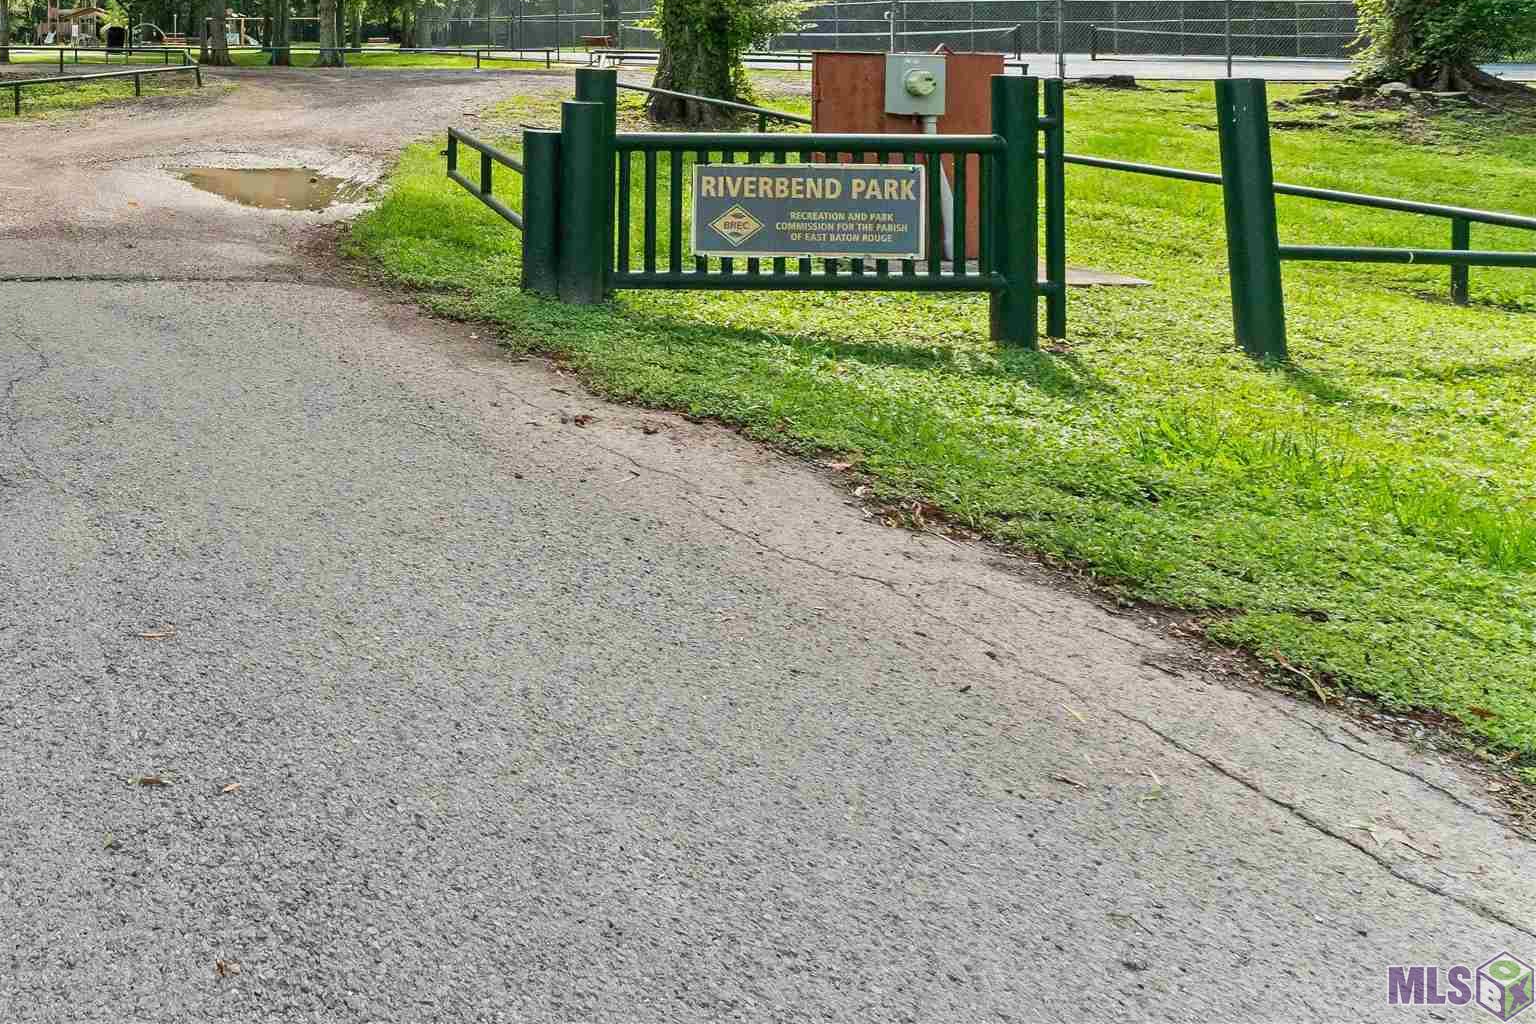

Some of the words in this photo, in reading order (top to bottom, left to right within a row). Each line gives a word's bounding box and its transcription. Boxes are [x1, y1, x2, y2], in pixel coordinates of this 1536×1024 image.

[700, 175, 842, 200] RIVERBEND
[850, 178, 917, 201] PARK
[789, 211, 846, 222] RECREATION
[847, 212, 869, 222] AND
[869, 212, 895, 222] PARK
[723, 220, 751, 230] BREC
[775, 222, 834, 232] COMMISSION
[836, 223, 855, 232] FOR
[857, 223, 875, 232] THE
[875, 223, 908, 233] PARISH
[790, 232, 803, 241] OF
[804, 232, 827, 242] EAST
[829, 233, 860, 242] BATON
[862, 233, 894, 243] ROUGE
